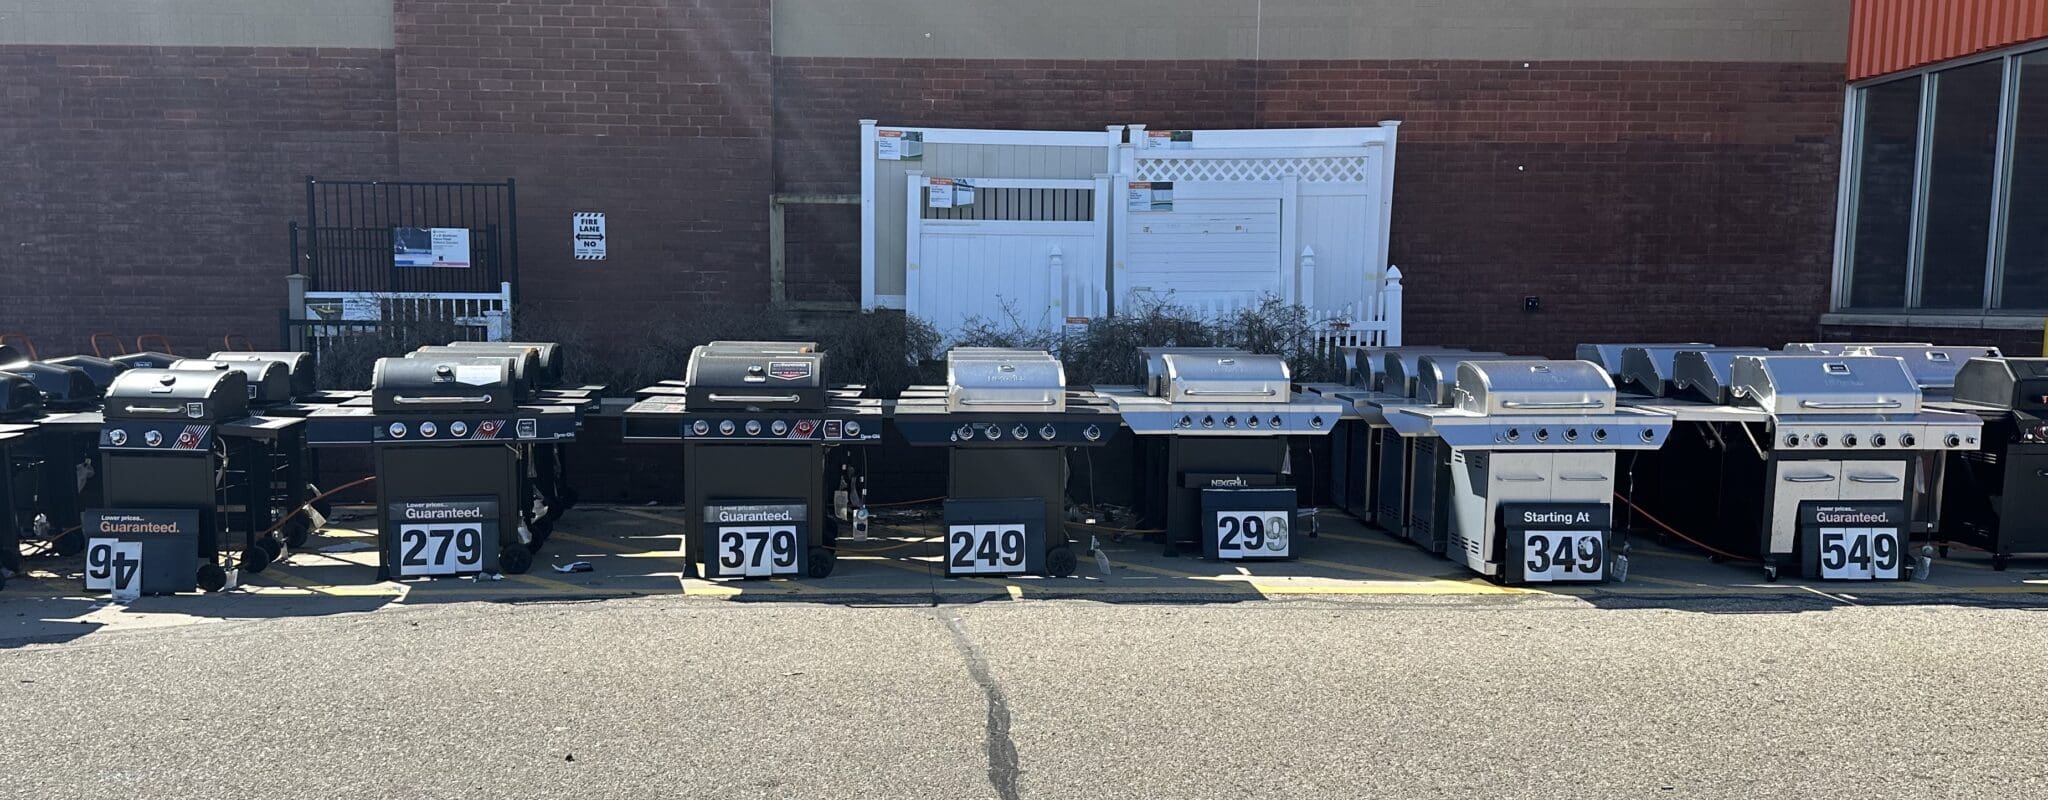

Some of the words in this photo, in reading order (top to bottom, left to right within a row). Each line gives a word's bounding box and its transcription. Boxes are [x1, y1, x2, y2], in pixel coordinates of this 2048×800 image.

[99, 521, 180, 533] Guaranteed.
[405, 507, 483, 519] Guaranteed.
[719, 511, 793, 522] Guaranteed.
[1524, 511, 1573, 524] Starting
[1576, 511, 1590, 523] At
[1816, 512, 1889, 524] Guaranteed.
[402, 528, 481, 566] 279
[720, 530, 796, 568] 379
[951, 530, 1025, 567] 249
[1218, 515, 1288, 552] 299
[1822, 533, 1898, 570] 549
[1526, 535, 1603, 573] 349
